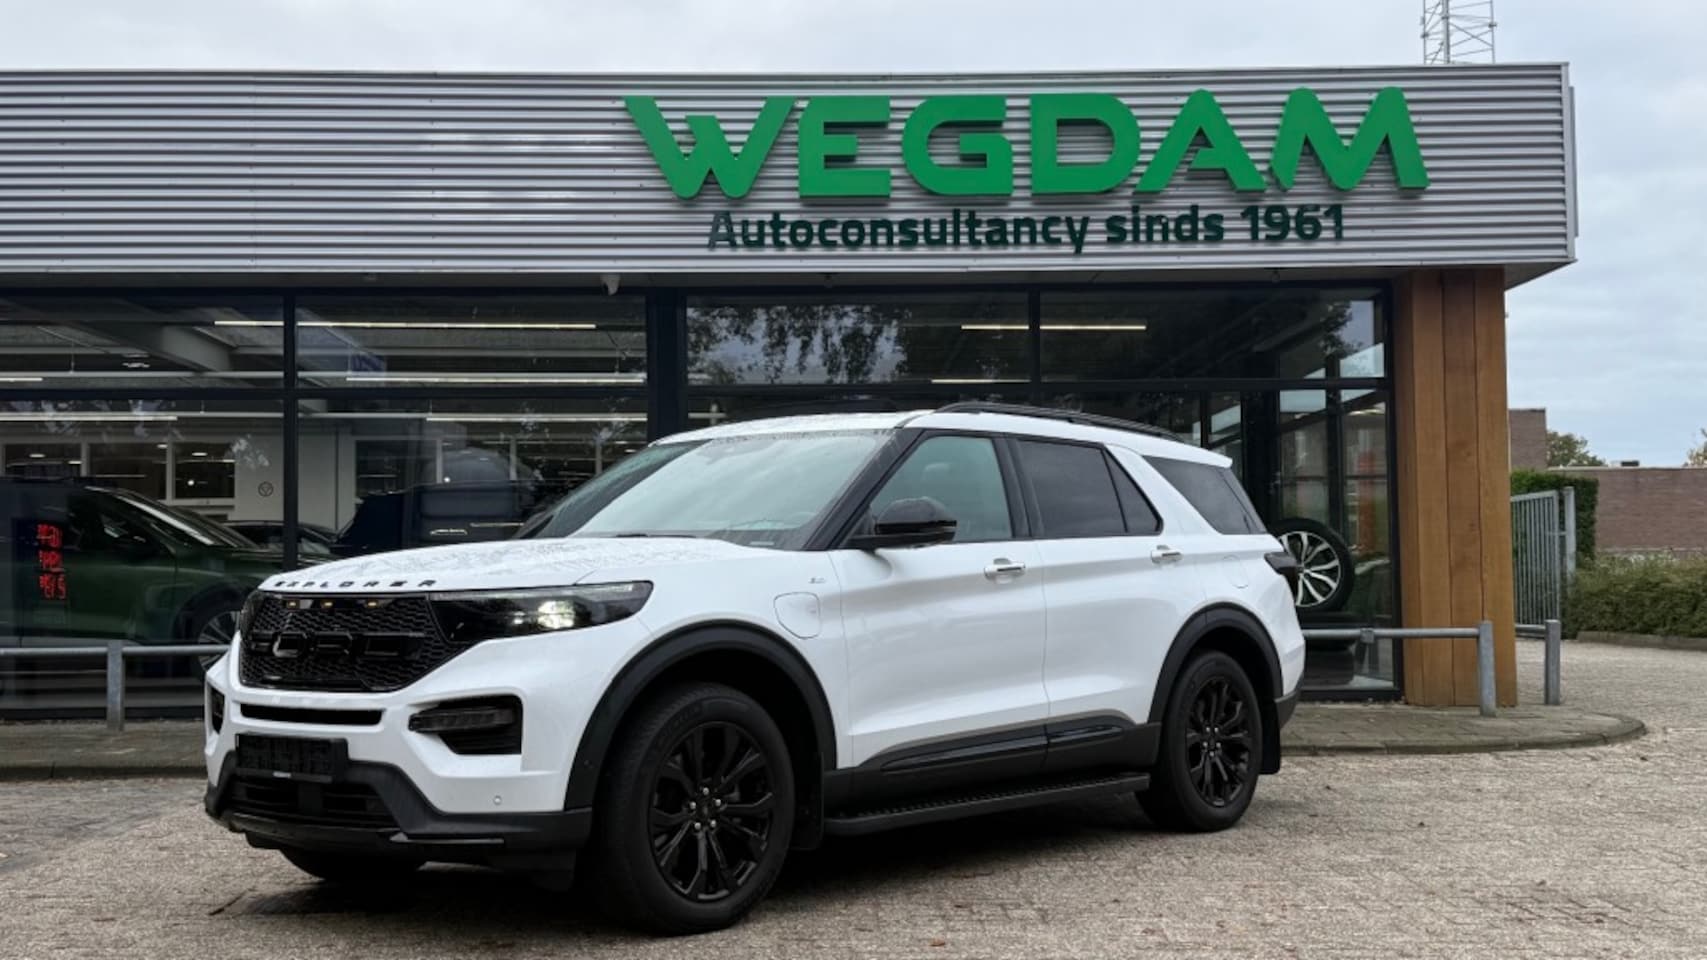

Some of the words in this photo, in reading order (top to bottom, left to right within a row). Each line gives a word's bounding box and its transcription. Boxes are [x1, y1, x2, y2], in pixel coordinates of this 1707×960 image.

[624, 86, 1429, 199] WEGDAM
[708, 207, 1090, 254] Autoconsultancy
[1105, 204, 1225, 243] sinds
[1240, 203, 1344, 241] 1961
